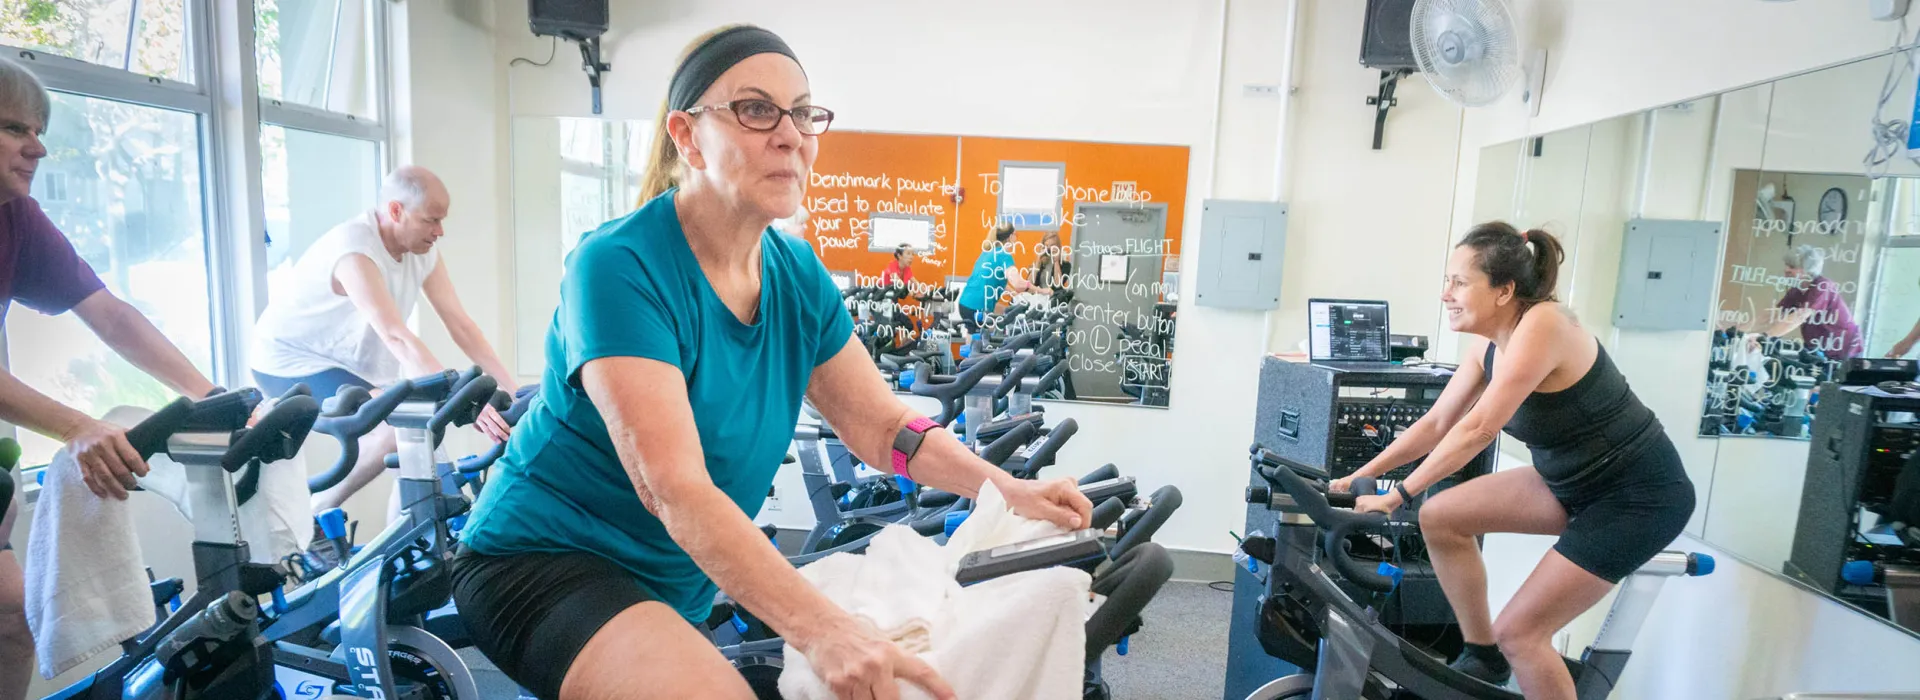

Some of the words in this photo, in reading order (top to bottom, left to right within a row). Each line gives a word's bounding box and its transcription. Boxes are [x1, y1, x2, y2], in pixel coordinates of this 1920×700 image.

[810, 166, 892, 190] benchmark
[897, 178, 938, 196] power
[978, 172, 1004, 195] To
[807, 193, 849, 213] used
[854, 195, 870, 213] to
[877, 197, 945, 216] calculate
[812, 215, 843, 237] your
[817, 234, 861, 257] power
[982, 239, 1026, 262] open
[1124, 239, 1174, 255] FLIGHT
[855, 269, 885, 290] hard
[890, 272, 905, 290] to
[846, 298, 932, 323] mprovement!
[1074, 302, 1131, 327] center
[877, 324, 894, 338] on
[896, 325, 917, 342] the
[1067, 329, 1087, 346] on
[1119, 337, 1166, 361] pedal
[1126, 360, 1165, 381] START
[387, 650, 423, 665] TAGES
